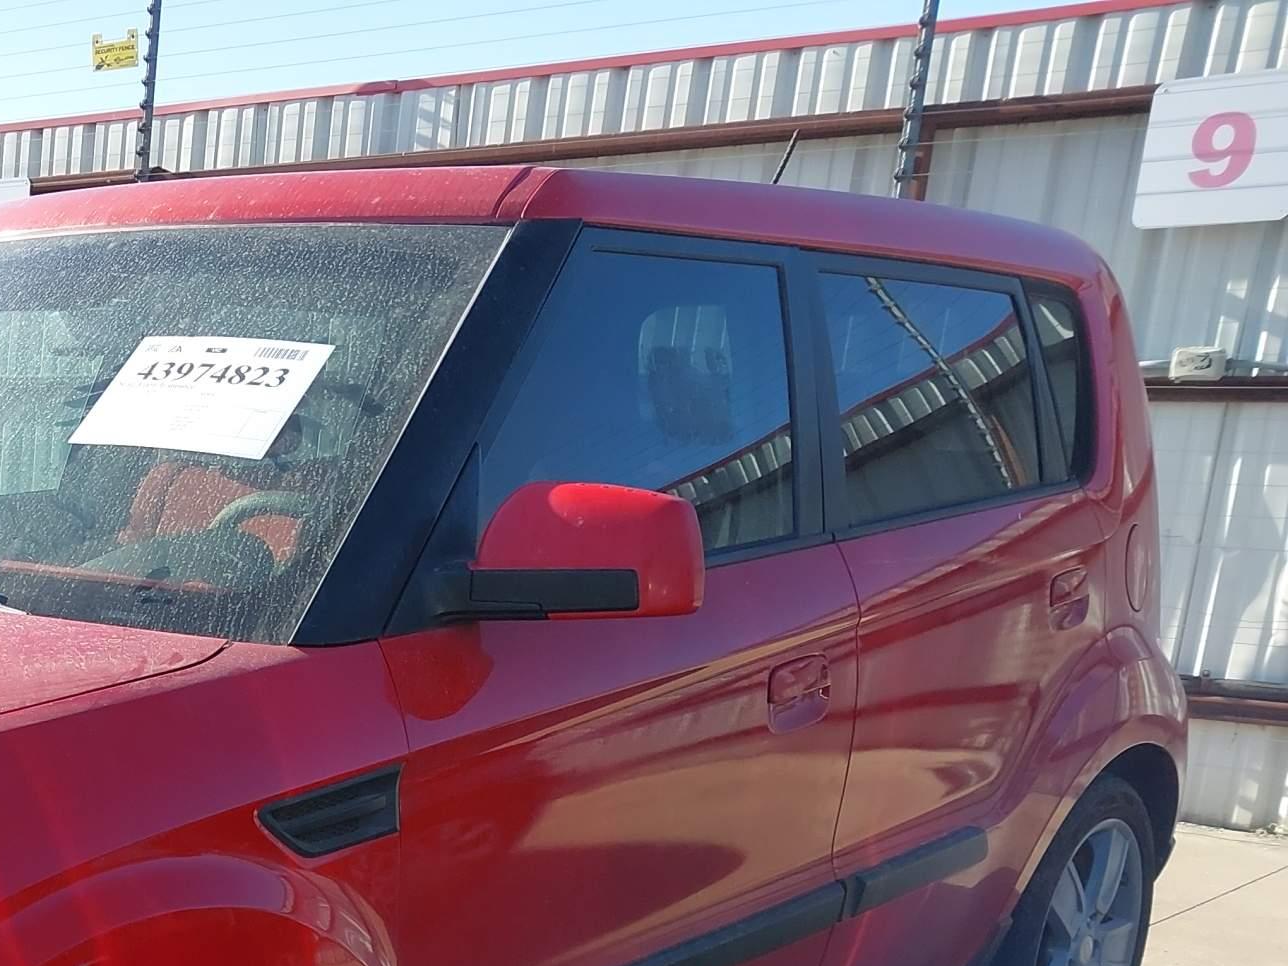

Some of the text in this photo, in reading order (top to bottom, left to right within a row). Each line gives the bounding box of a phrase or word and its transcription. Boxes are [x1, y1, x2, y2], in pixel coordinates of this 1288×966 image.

[95, 47, 118, 55] SECURITY
[119, 44, 135, 52] FENCE
[1187, 111, 1257, 189] 9
[137, 361, 290, 388] 43974823
